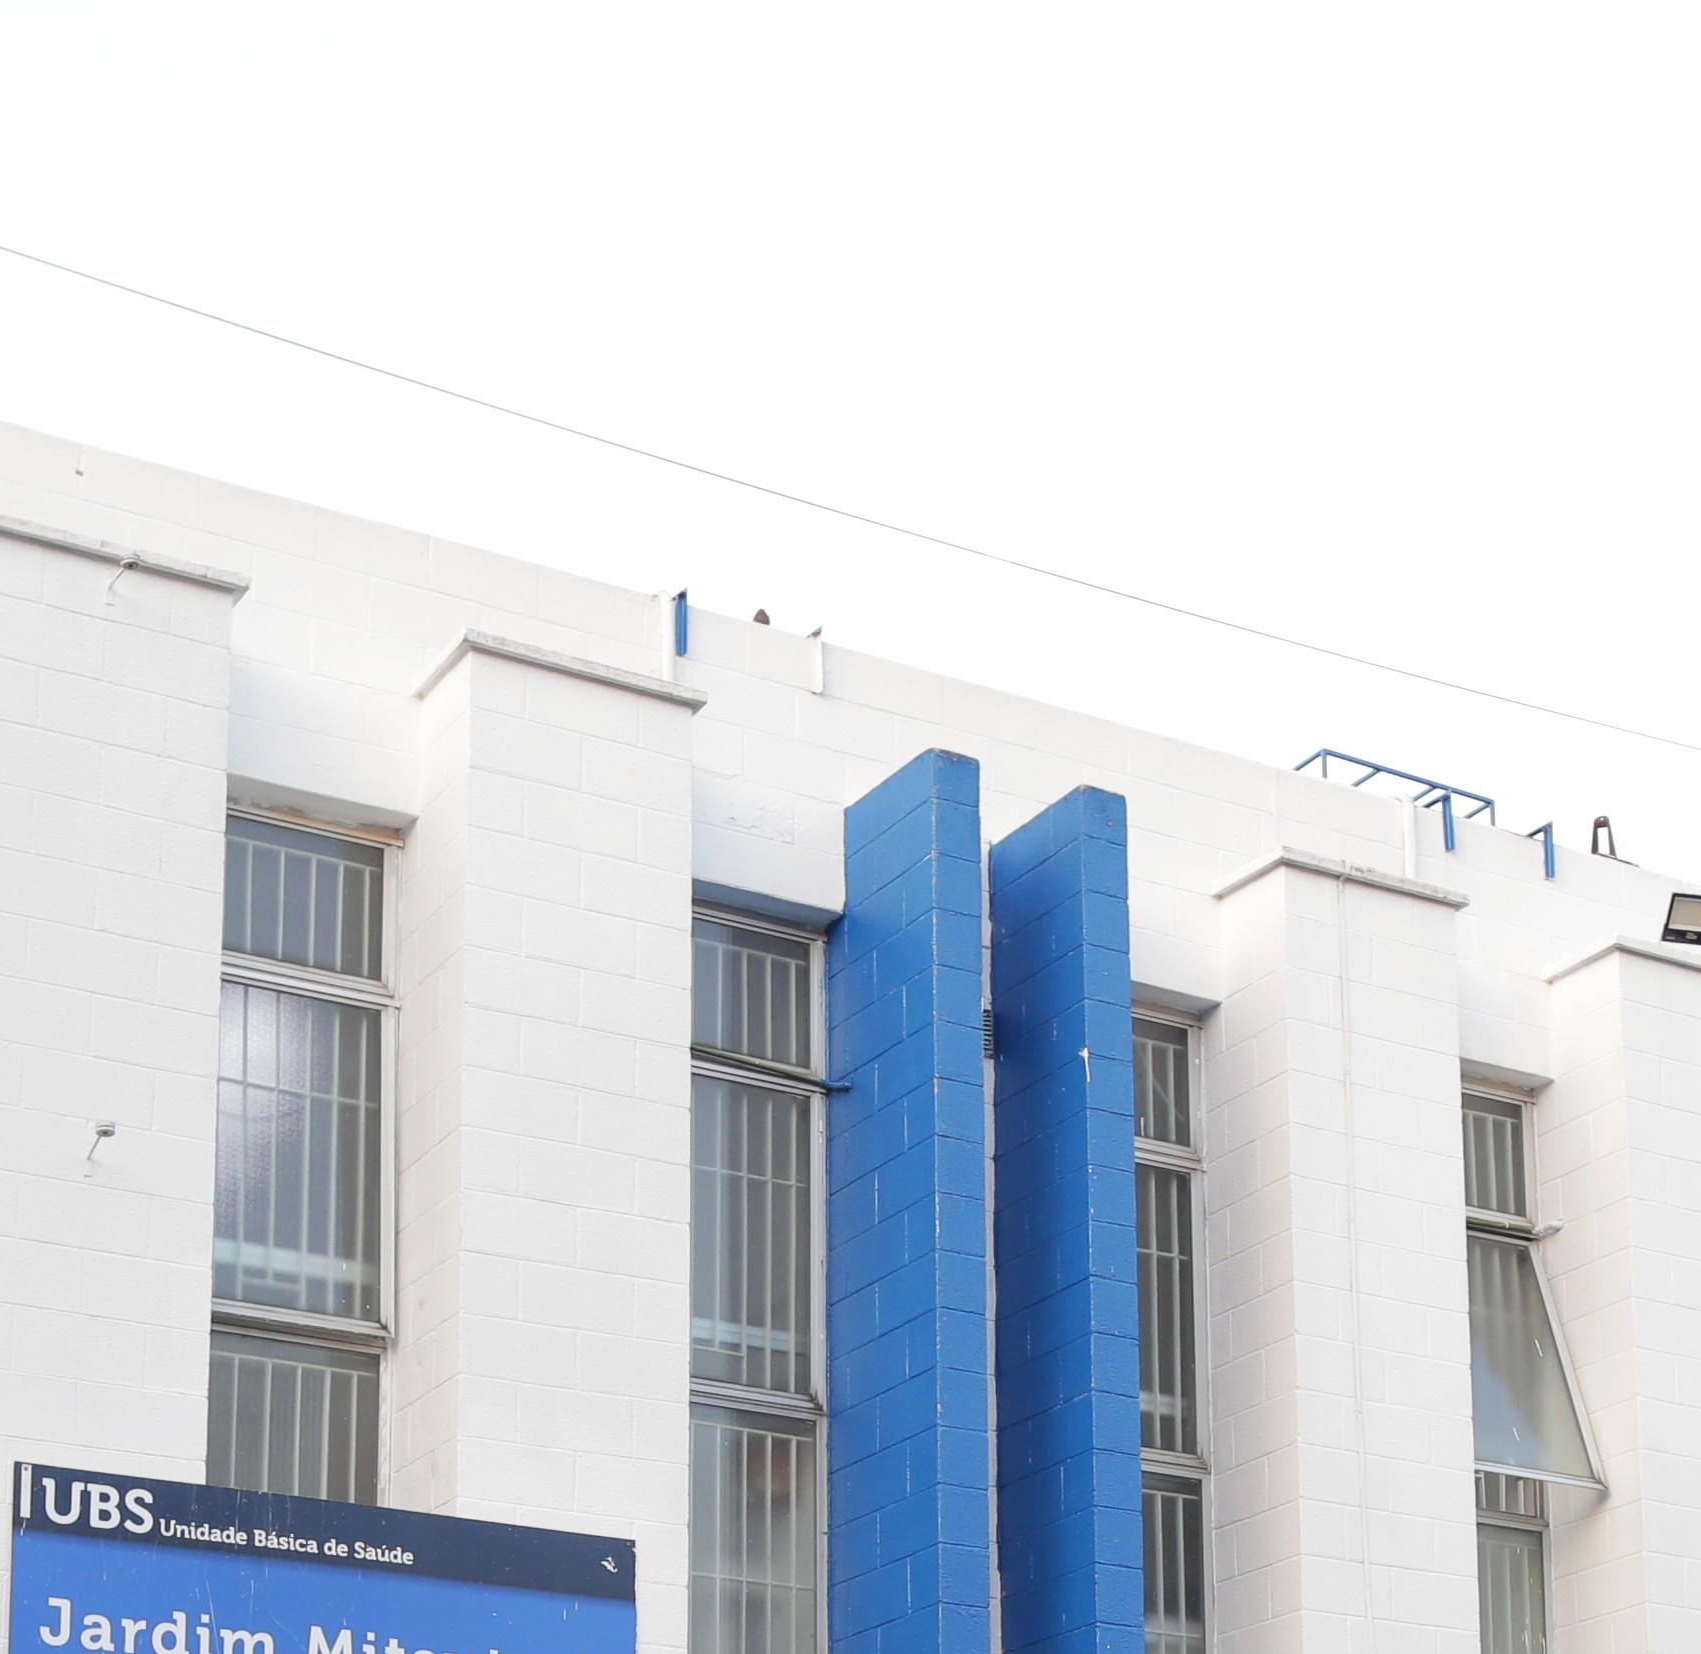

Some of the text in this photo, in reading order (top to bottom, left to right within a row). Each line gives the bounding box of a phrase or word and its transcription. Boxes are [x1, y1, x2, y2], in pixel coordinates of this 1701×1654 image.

[42, 1478, 414, 1566] UBS Unidade Básica de Saúde
